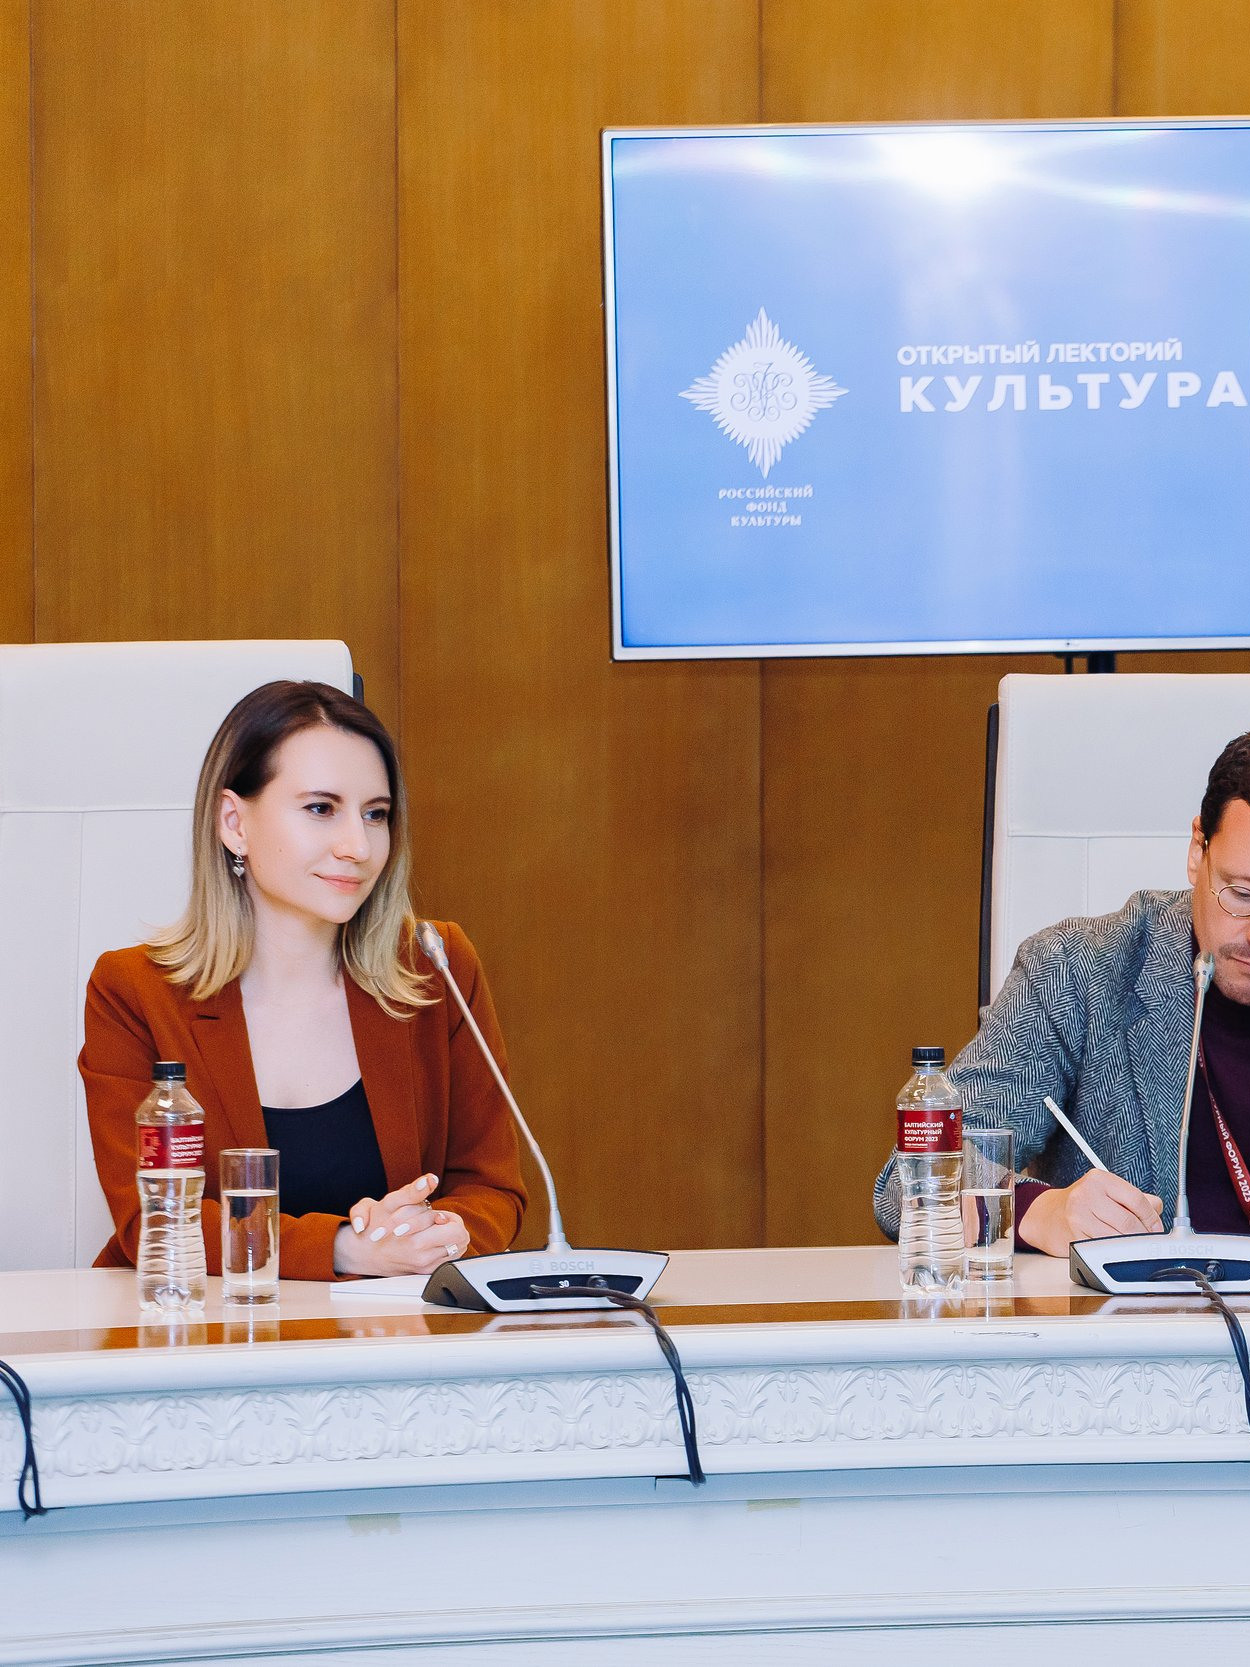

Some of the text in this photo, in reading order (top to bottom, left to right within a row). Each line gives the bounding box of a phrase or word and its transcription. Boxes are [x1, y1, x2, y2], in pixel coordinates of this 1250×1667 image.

[897, 338, 1183, 366] ОТКРЫТЫЙ ЛЕКТОРИЙ
[899, 371, 1249, 413] КУЛЬТУРА
[718, 485, 813, 500] РОССИЙСКИЙ
[745, 501, 787, 513] ФОНД
[731, 515, 802, 527] КУЛЬТУРЫ
[1225, 1141, 1245, 1179] ФОРУМ
[1169, 1244, 1214, 1255] BOSCH
[550, 1261, 595, 1272] BOSCH
[558, 1280, 570, 1288] 30
